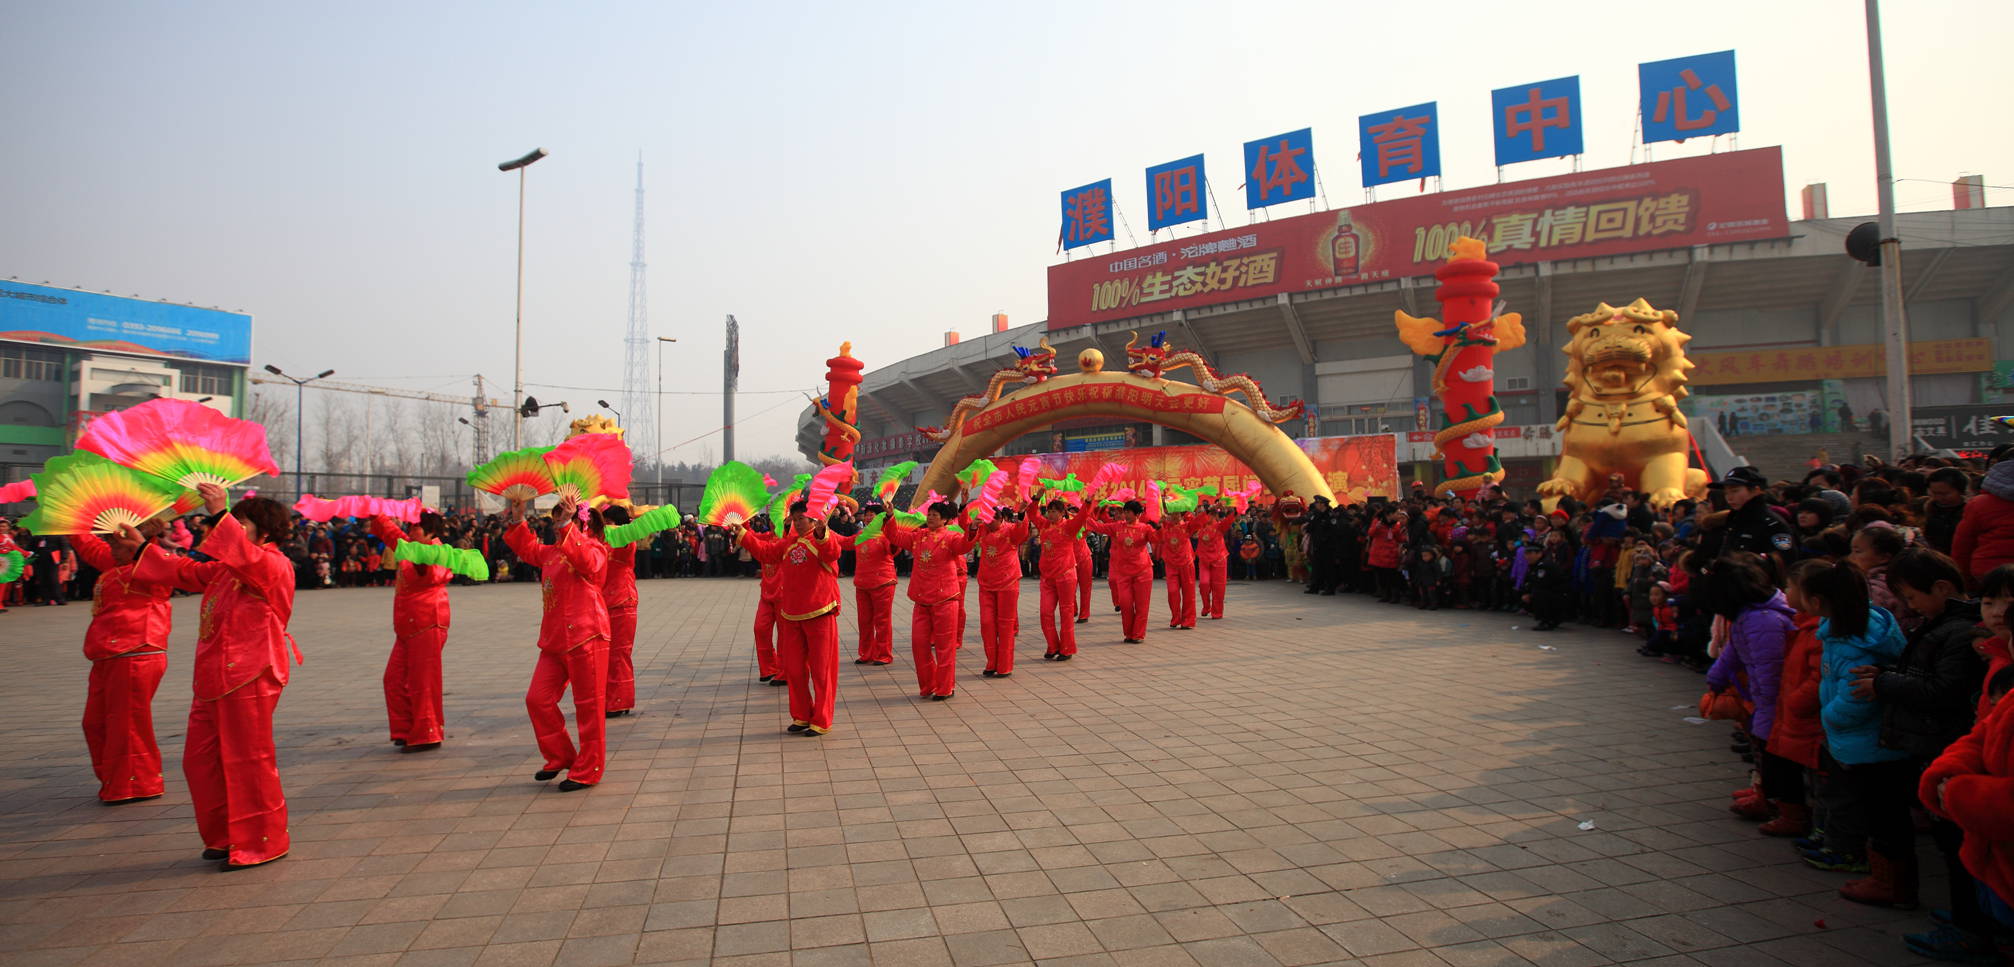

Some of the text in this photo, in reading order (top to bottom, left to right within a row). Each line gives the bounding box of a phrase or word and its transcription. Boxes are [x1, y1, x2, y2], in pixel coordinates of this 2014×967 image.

[1413, 193, 1690, 263] 100%真情回馈
[1091, 252, 1277, 312] 100%生态好酒
